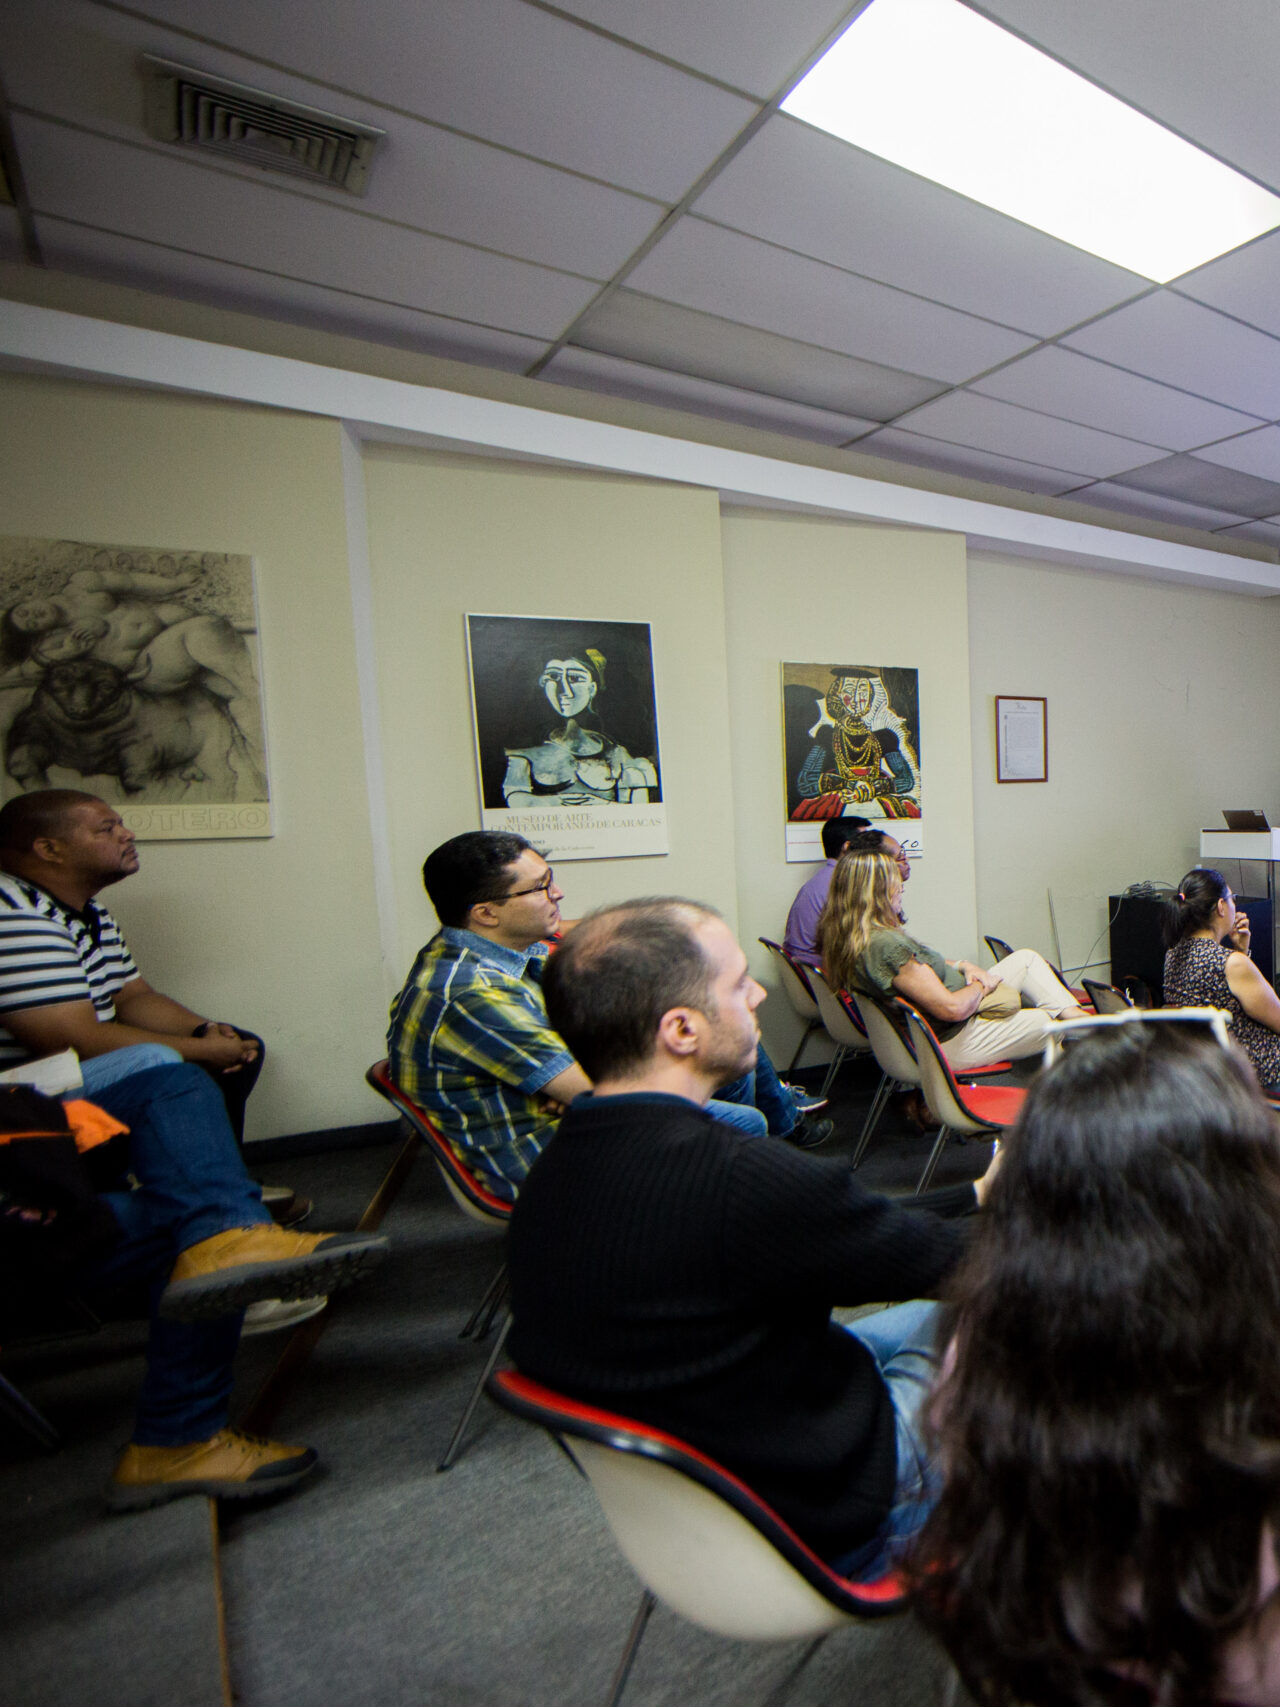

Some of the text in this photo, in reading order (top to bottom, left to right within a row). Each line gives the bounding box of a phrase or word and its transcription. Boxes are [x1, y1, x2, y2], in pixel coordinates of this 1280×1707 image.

[121, 807, 269, 832] OTERO
[506, 812, 593, 825] MUSEO DE ARTE
[596, 820, 611, 830] DE
[612, 817, 662, 829] CARACAS
